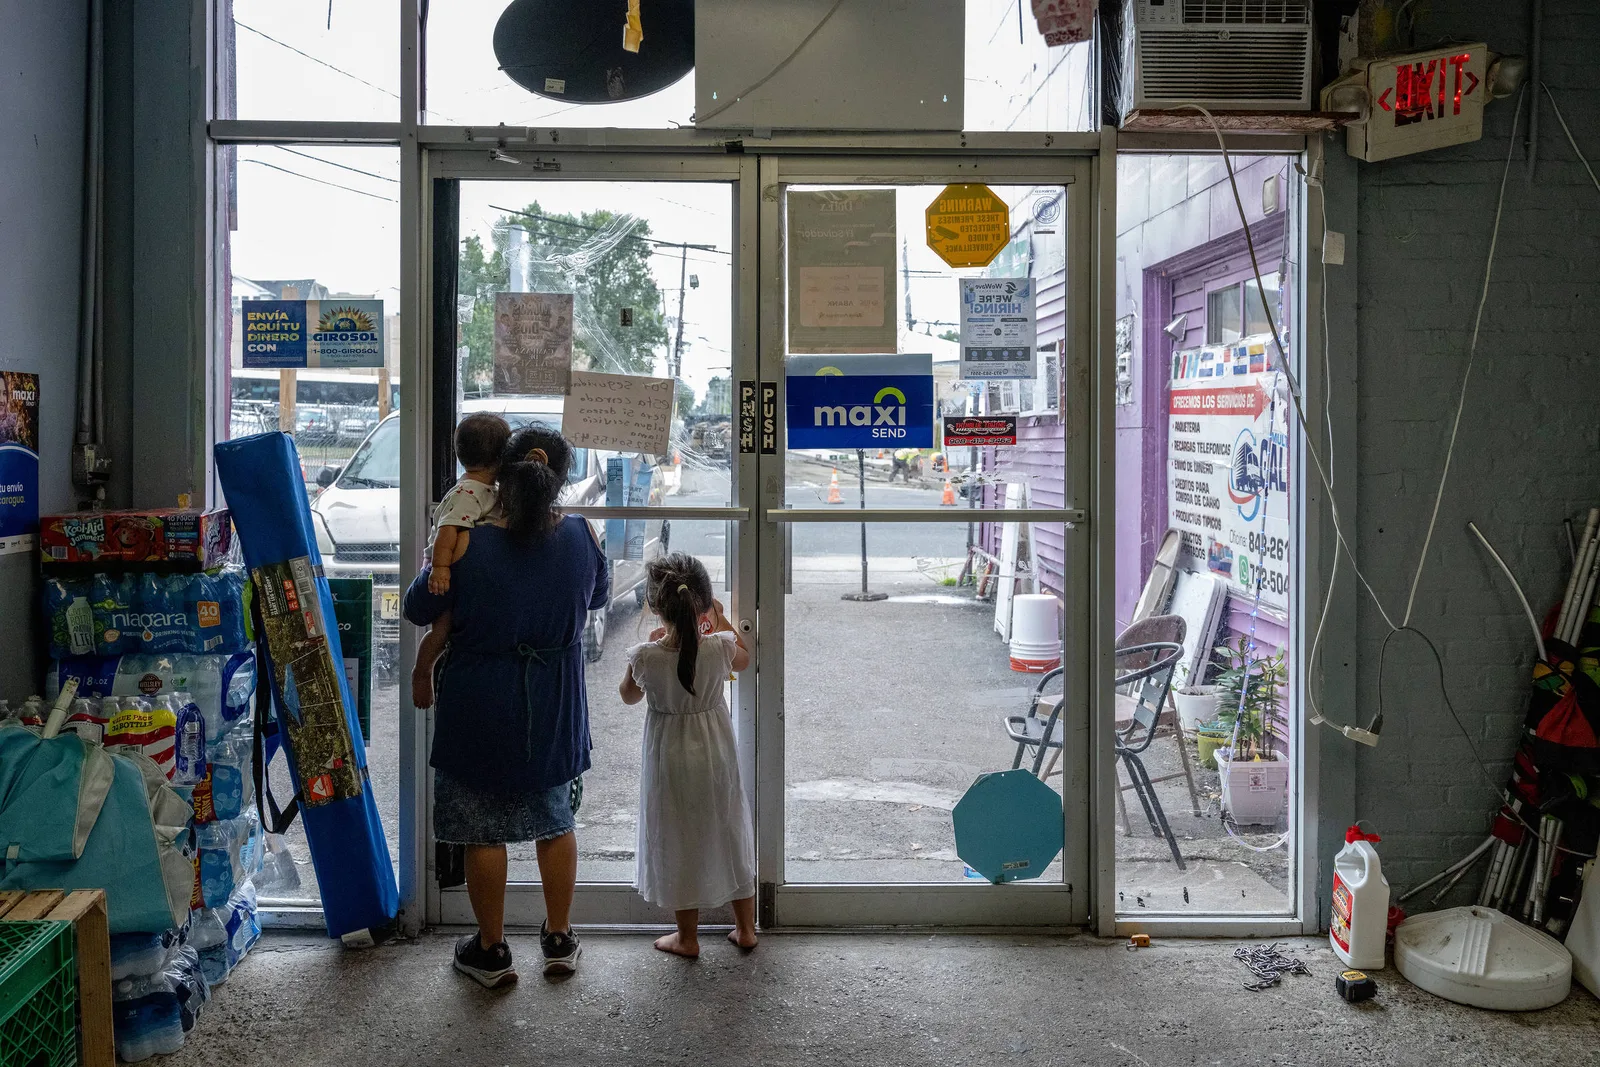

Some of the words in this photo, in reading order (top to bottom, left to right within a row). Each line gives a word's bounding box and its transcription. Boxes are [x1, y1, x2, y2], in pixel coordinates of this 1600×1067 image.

[248, 310, 288, 320] ENVÍA
[248, 321, 280, 331] AQUÍ
[281, 322, 300, 331] TU
[248, 333, 299, 342] DINERO
[312, 332, 378, 342] GIROSOL
[247, 344, 276, 352] CON
[12, 388, 34, 401] maxi
[1173, 395, 1200, 409] OFRECEMOS
[1202, 395, 1215, 408] LOS
[1217, 394, 1246, 408] SERVICIOS
[764, 389, 774, 448] PUSH
[814, 405, 906, 426] maxi
[872, 428, 906, 438] SEND
[1175, 421, 1200, 433] PAQUETERIA
[1174, 440, 1196, 452] RECARGAS
[1197, 442, 1231, 456] TELEFONICAS
[1174, 460, 1186, 471] ENVIO
[1187, 462, 1193, 472] DE
[7, 482, 24, 492] envío
[1175, 478, 1194, 491] CREDITOS
[1196, 482, 1210, 494] PARA
[0, 496, 25, 507] aragua.
[1176, 491, 1194, 505] COMPRA
[1195, 495, 1201, 506] DE
[1203, 496, 1220, 510] CARRO
[1175, 510, 1201, 526] PRODUCTOS
[1203, 515, 1222, 531] TIPICOS
[63, 518, 104, 538] Kool-Aid
[70, 534, 104, 546] Jammers
[1181, 530, 1202, 545] ODUCTOS
[1249, 531, 1288, 561] 848-26
[1249, 563, 1288, 594] 72-504
[200, 606, 217, 616] 40
[112, 613, 188, 631] niagara
[113, 715, 131, 724] VALUE
[120, 721, 153, 729] BOTTLES
